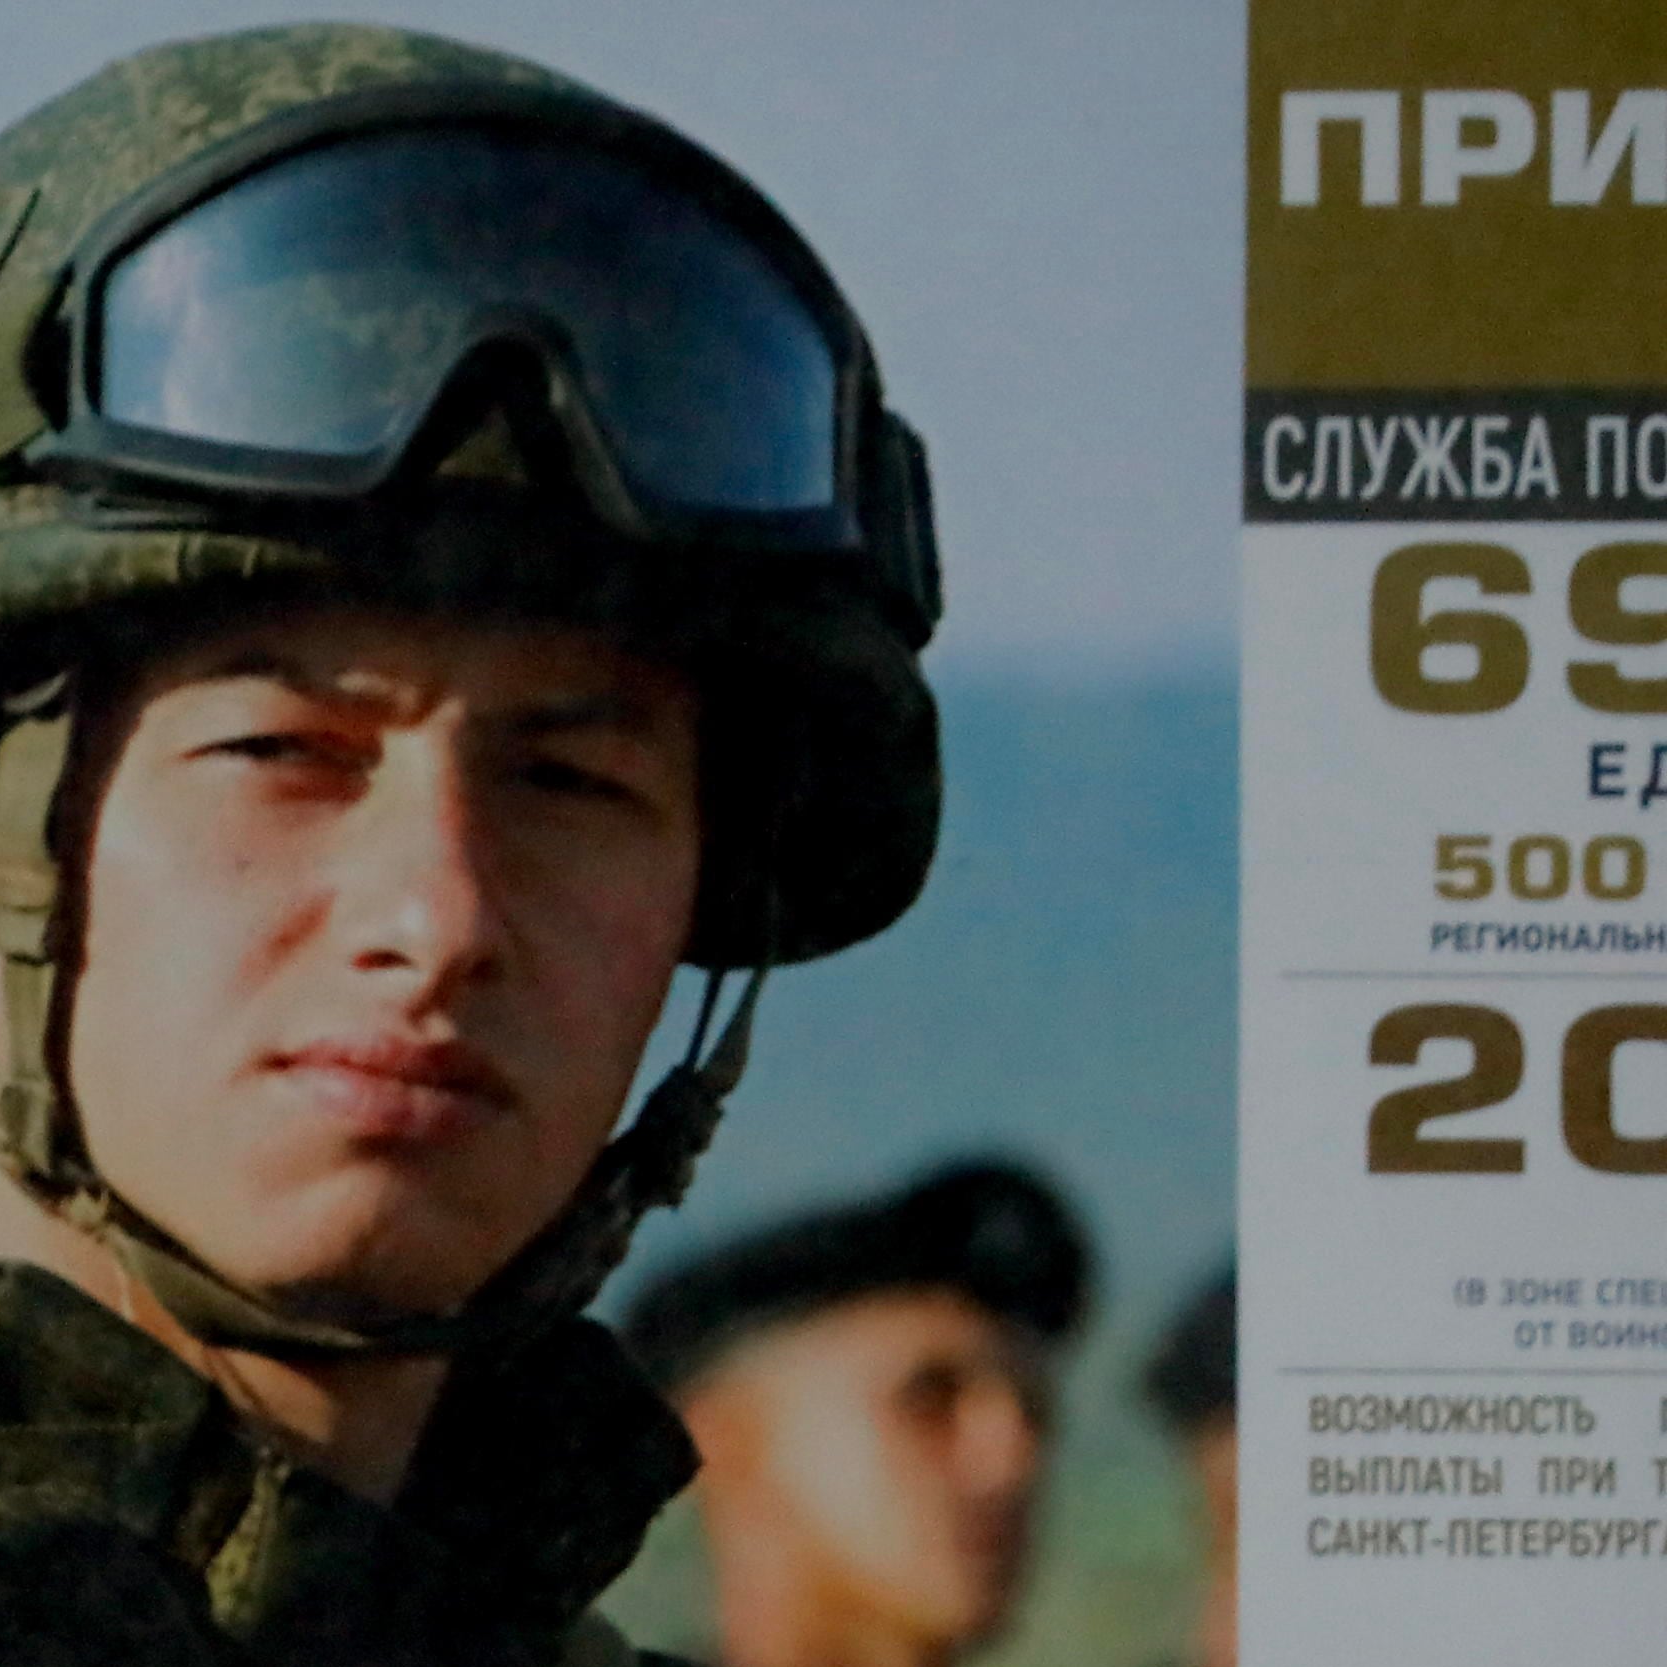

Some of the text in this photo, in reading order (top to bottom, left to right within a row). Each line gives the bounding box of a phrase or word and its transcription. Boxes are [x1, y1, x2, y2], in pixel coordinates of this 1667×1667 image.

[1279, 88, 1667, 207] ПРИ
[1262, 414, 1559, 502] СЛУЖБА
[1434, 833, 1647, 902] 500
[1452, 1278, 1485, 1309] (В
[1500, 1278, 1583, 1308] ЗОНЕ
[1515, 1320, 1553, 1351] ОТ
[1307, 1394, 1597, 1435] ВОЗМОЖНОСТЬ
[1307, 1456, 1503, 1497] ВЫПЛАТЫ
[1538, 1457, 1617, 1497] ПРИ
